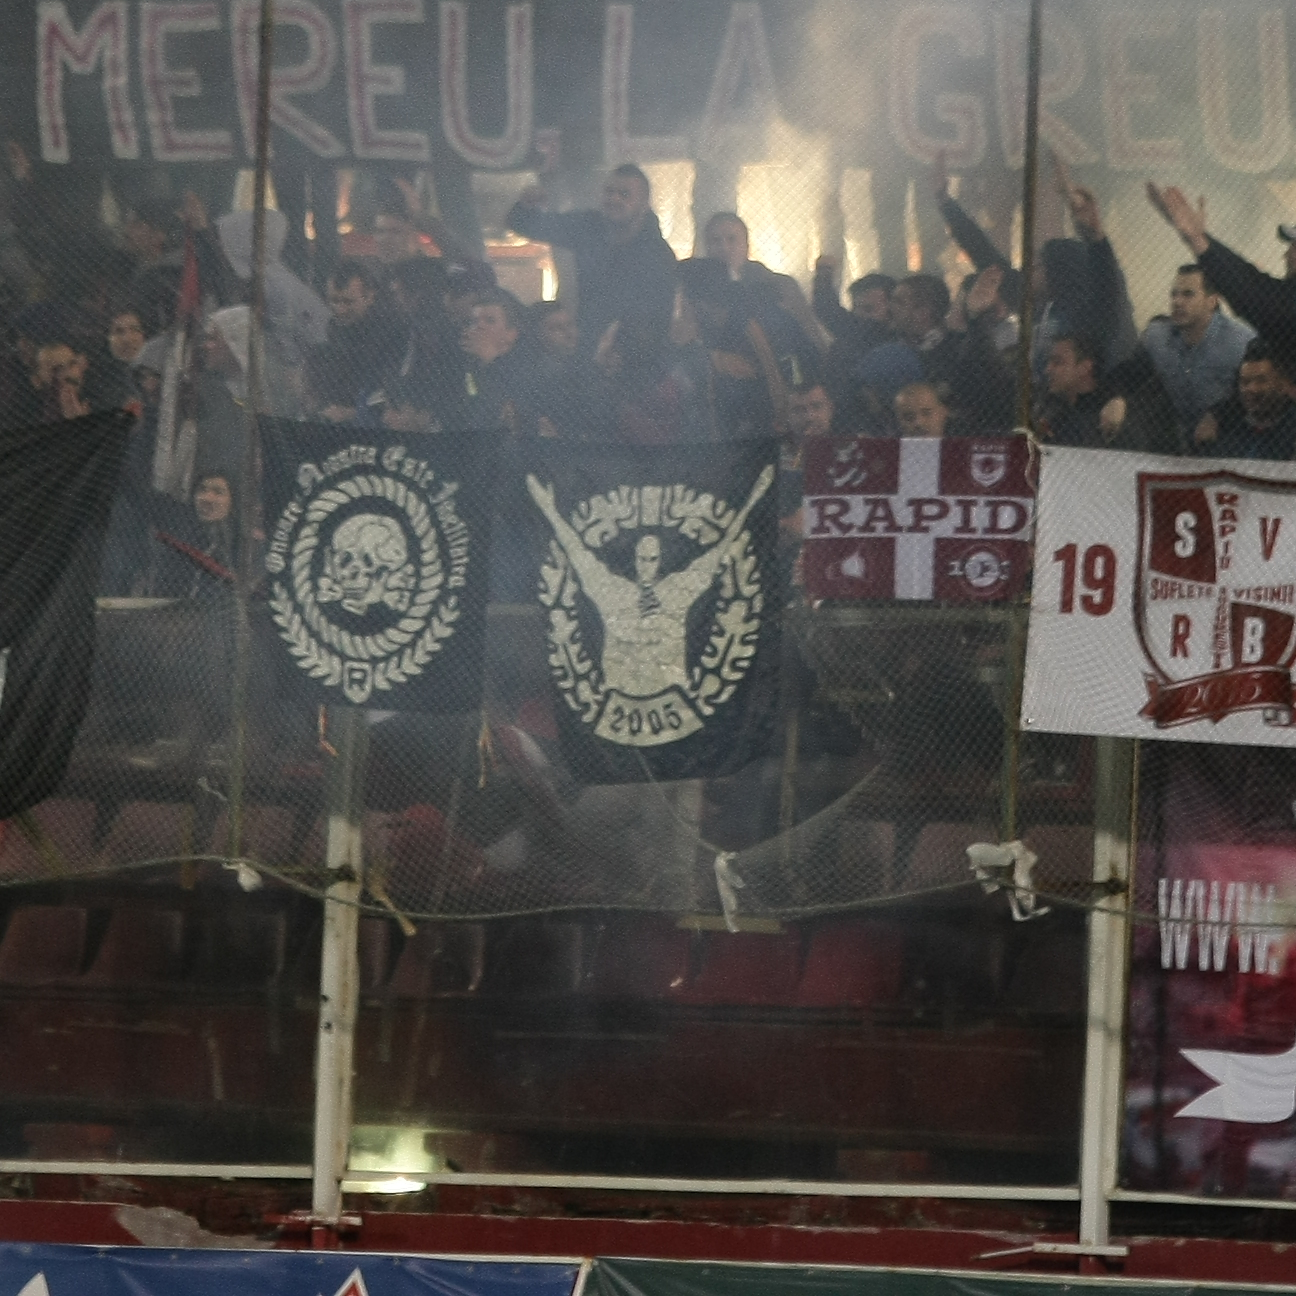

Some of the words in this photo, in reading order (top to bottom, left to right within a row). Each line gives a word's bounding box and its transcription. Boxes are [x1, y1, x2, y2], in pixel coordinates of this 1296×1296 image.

[602, 0, 789, 166] LA
[808, 497, 1030, 536] RAPID
[1174, 511, 1198, 559] S
[1259, 516, 1282, 562] V
[1053, 542, 1118, 617] 19
[1170, 613, 1192, 659] R
[1241, 616, 1266, 664] B
[609, 702, 682, 736] 2005
